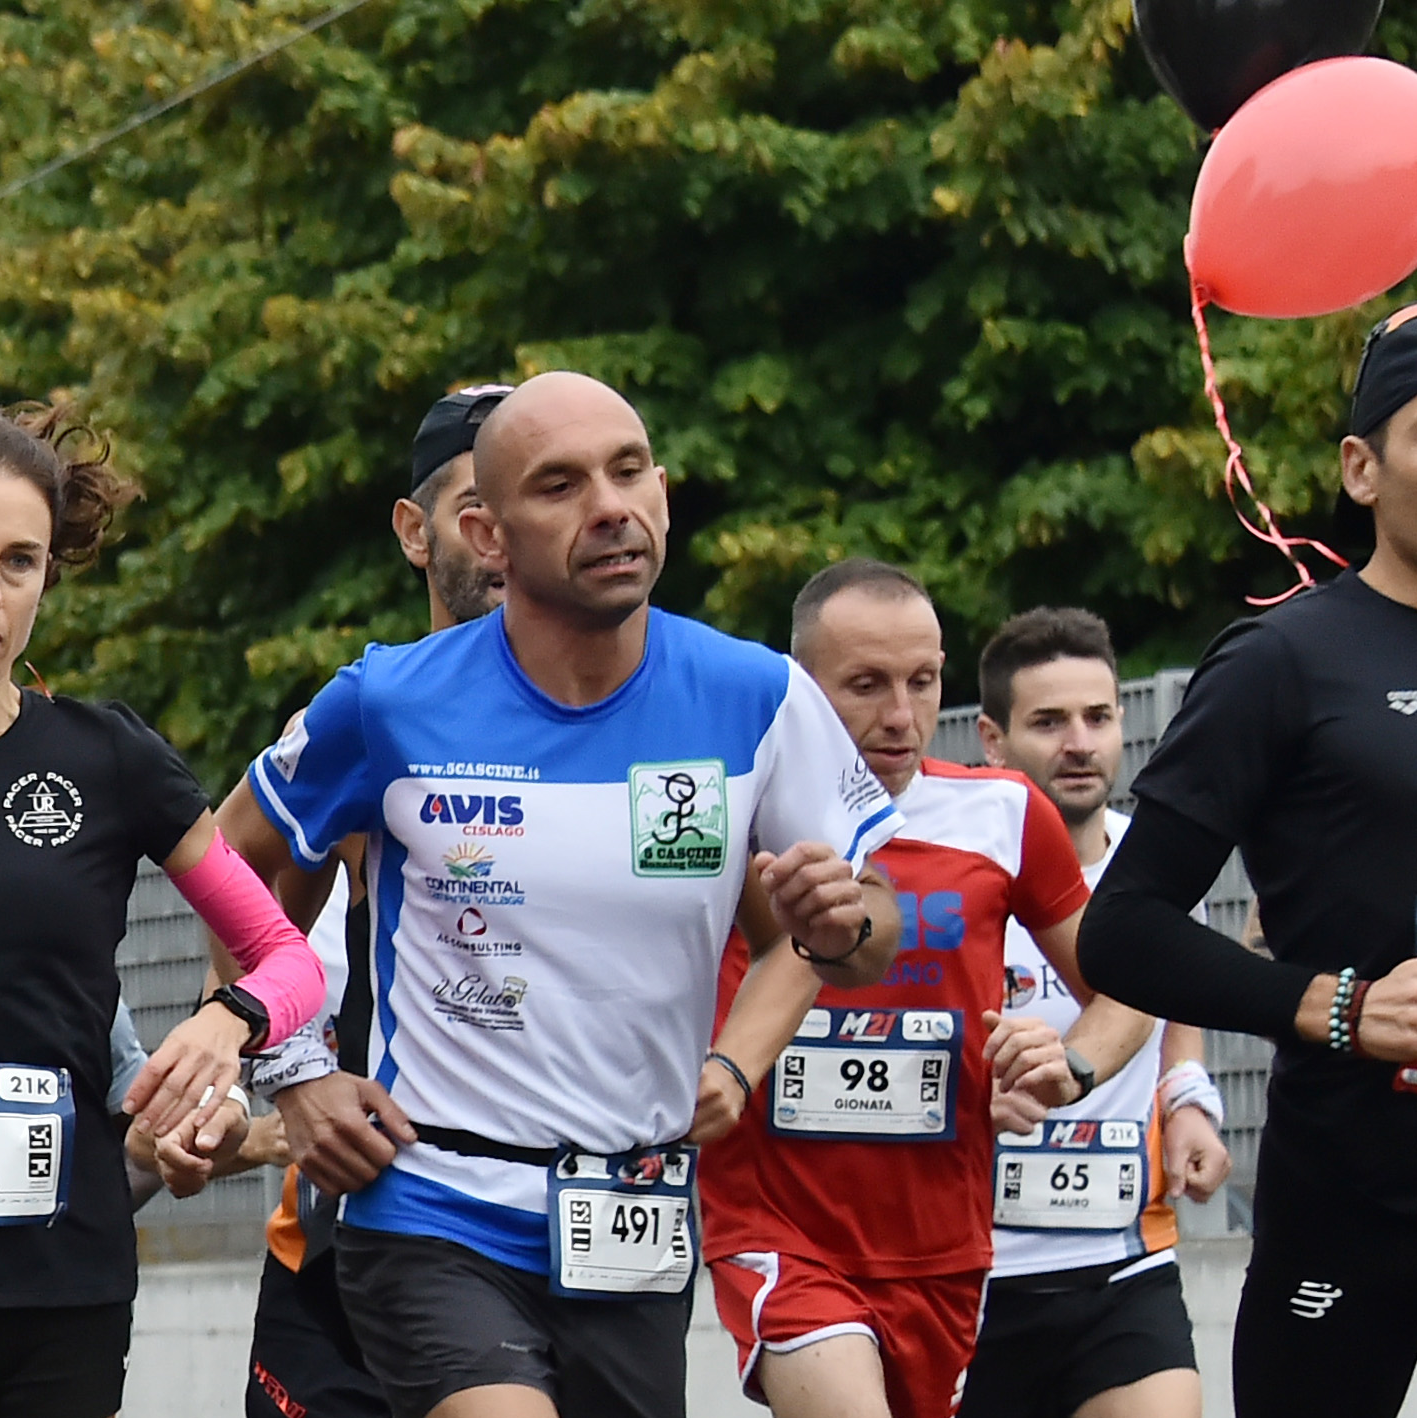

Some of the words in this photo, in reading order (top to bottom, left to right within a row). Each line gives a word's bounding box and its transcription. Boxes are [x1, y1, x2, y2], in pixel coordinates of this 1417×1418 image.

[407, 762, 540, 780] www.5CASCINE.it
[3, 772, 38, 808] PACER
[46, 771, 83, 807] PACER
[419, 793, 524, 825] AVIS
[5, 814, 43, 847] PACER
[51, 812, 84, 847] PACER
[462, 825, 525, 837] CISLAGO
[425, 876, 525, 894] CONTINENTAL
[838, 1011, 898, 1036] M21
[912, 1019, 933, 1034] 21
[10, 1076, 52, 1096] 21K
[840, 1059, 889, 1092] 98
[834, 1098, 894, 1111] GIONATA
[1109, 1128, 1134, 1141] 21K
[1050, 1163, 1090, 1191] 65
[1049, 1198, 1090, 1208] MAURO
[610, 1204, 660, 1245] 491
